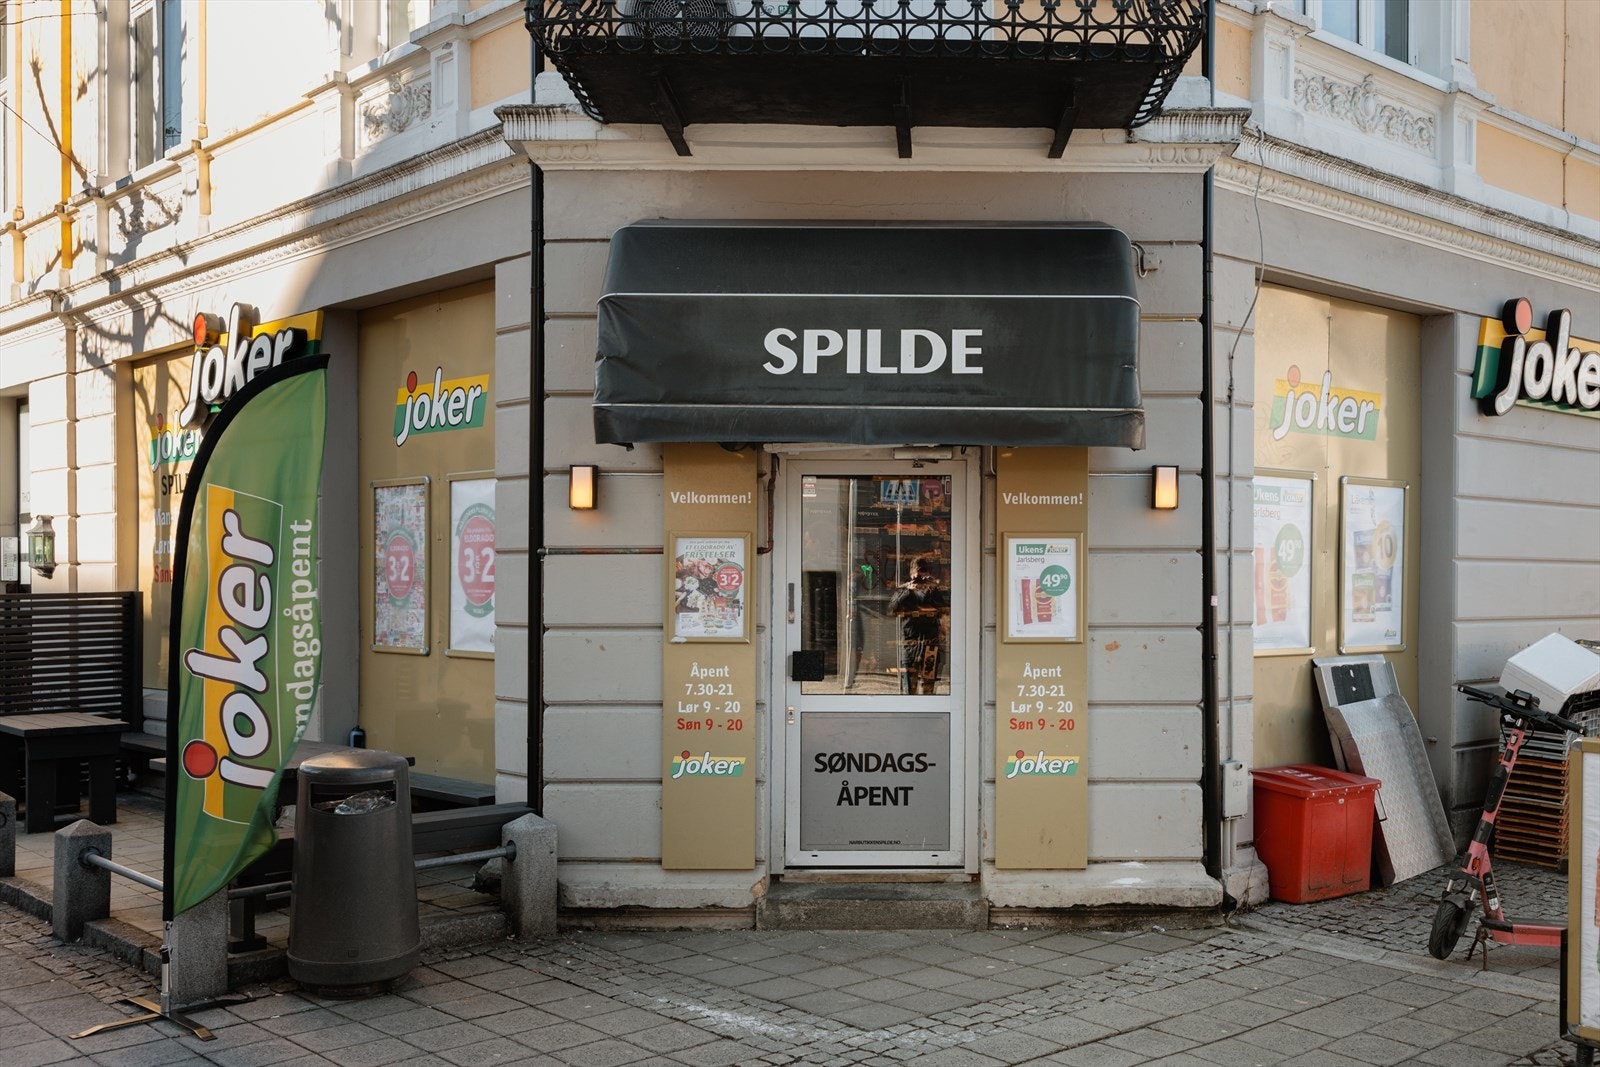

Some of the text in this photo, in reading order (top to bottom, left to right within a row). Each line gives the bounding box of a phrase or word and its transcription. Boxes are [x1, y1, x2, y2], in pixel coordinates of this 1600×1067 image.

[762, 327, 984, 375] SPILDE
[179, 302, 295, 429] joker
[396, 366, 482, 447] joker
[1273, 365, 1374, 441] joker
[162, 474, 190, 495] SPIL
[670, 491, 752, 504] Velkommen!
[1002, 492, 1083, 505] Velkommen!
[1254, 488, 1279, 502] Ukens
[1254, 506, 1281, 520] arlsberg
[1019, 544, 1044, 554] Ukens
[463, 547, 475, 583] 3
[481, 547, 494, 583] 2
[1016, 556, 1046, 564] Jarlsberg
[182, 508, 275, 789] joker
[690, 662, 729, 679] Åpent
[1023, 662, 1062, 680] Åpent
[685, 683, 734, 696] 7.30-21
[1017, 684, 1066, 697] 7.30-21
[678, 701, 699, 713] Lør
[703, 701, 711, 713] 9
[724, 701, 741, 713] 20
[1011, 701, 1032, 713] Lør
[1035, 701, 1044, 713] 9
[1057, 701, 1073, 713] 20
[677, 718, 701, 731] Søn
[705, 718, 713, 731] 9
[726, 718, 743, 731] 20
[1009, 718, 1034, 731] Søn
[1037, 718, 1046, 731] 9
[1058, 718, 1075, 731] 20
[672, 750, 740, 779] joker
[814, 752, 937, 774] SØNDAGS-
[1007, 750, 1074, 779] joker
[836, 780, 914, 806] ÅPENT
